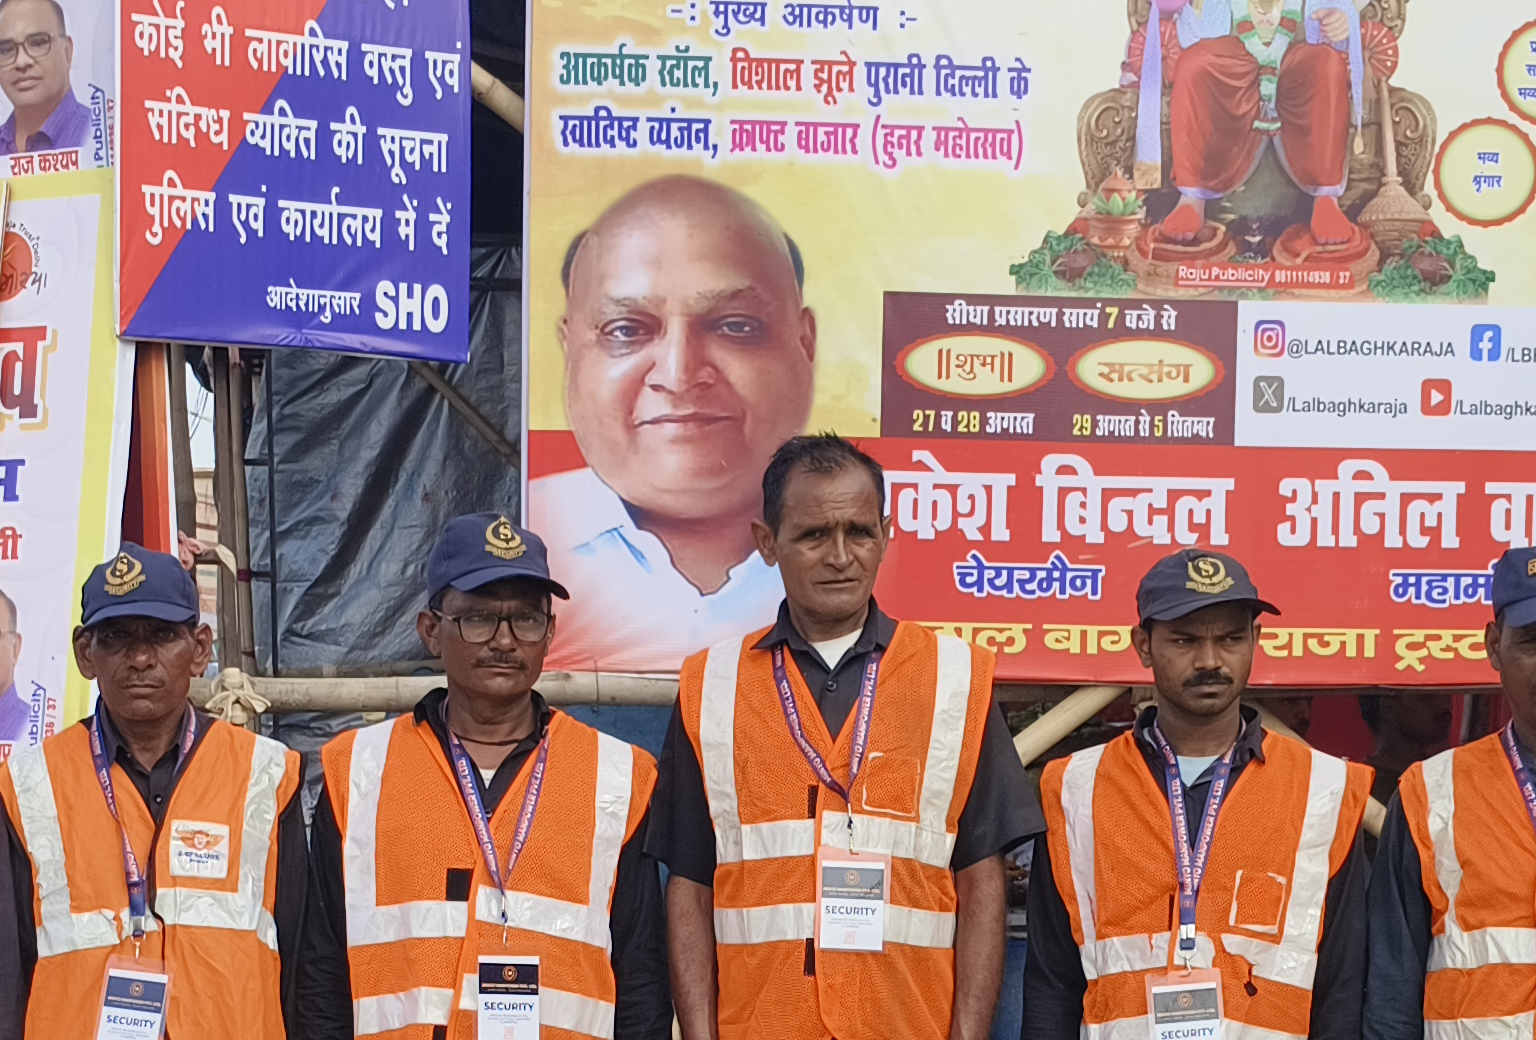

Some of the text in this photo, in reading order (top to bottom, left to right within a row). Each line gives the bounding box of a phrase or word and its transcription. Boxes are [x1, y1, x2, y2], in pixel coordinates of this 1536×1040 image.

[131, 1, 461, 106] कोई भी लावारिस वस्तु एवं
[559, 43, 1031, 107] आकर्षक स्टॉल, विशाल झूले पुरानी दिल्ली के
[92, 84, 106, 167] Publicity
[145, 86, 448, 185] संदिग्ध व्यक्ति की सूचना
[559, 105, 1024, 171] स्वादिष्ट व्यंजन, क्राफ्ट बाजार (हुनर महोत्सव)
[10, 149, 79, 177] राज कश्यप
[141, 170, 451, 254] पुलिस एवं कार्यालय में दें
[1178, 265, 1271, 284] Raju Publicity
[266, 278, 361, 323] आदेशानुसार
[374, 280, 449, 333] SHO
[946, 300, 1178, 330] सीधा प्रसारण सायं 7 बजे से
[1287, 338, 1456, 358] @LALBAGHKARAJA
[1097, 359, 1194, 383] सत्संग
[1286, 396, 1408, 418] /Lalbaghkaraja
[913, 410, 1035, 435] 27 व 28 अगस्त
[1072, 410, 1215, 438] 29 अगस्त से 5 सितम्बर
[1035, 453, 1236, 546] बिन्दल
[1277, 459, 1465, 548] अनिल
[956, 551, 1103, 597] चेयरमैन
[1260, 628, 1381, 658] राजा
[824, 904, 878, 917] SECURITY
[106, 1012, 157, 1032] SECURITY
[484, 1001, 535, 1013] SECURITY
[1160, 1026, 1215, 1040] SECURITY
